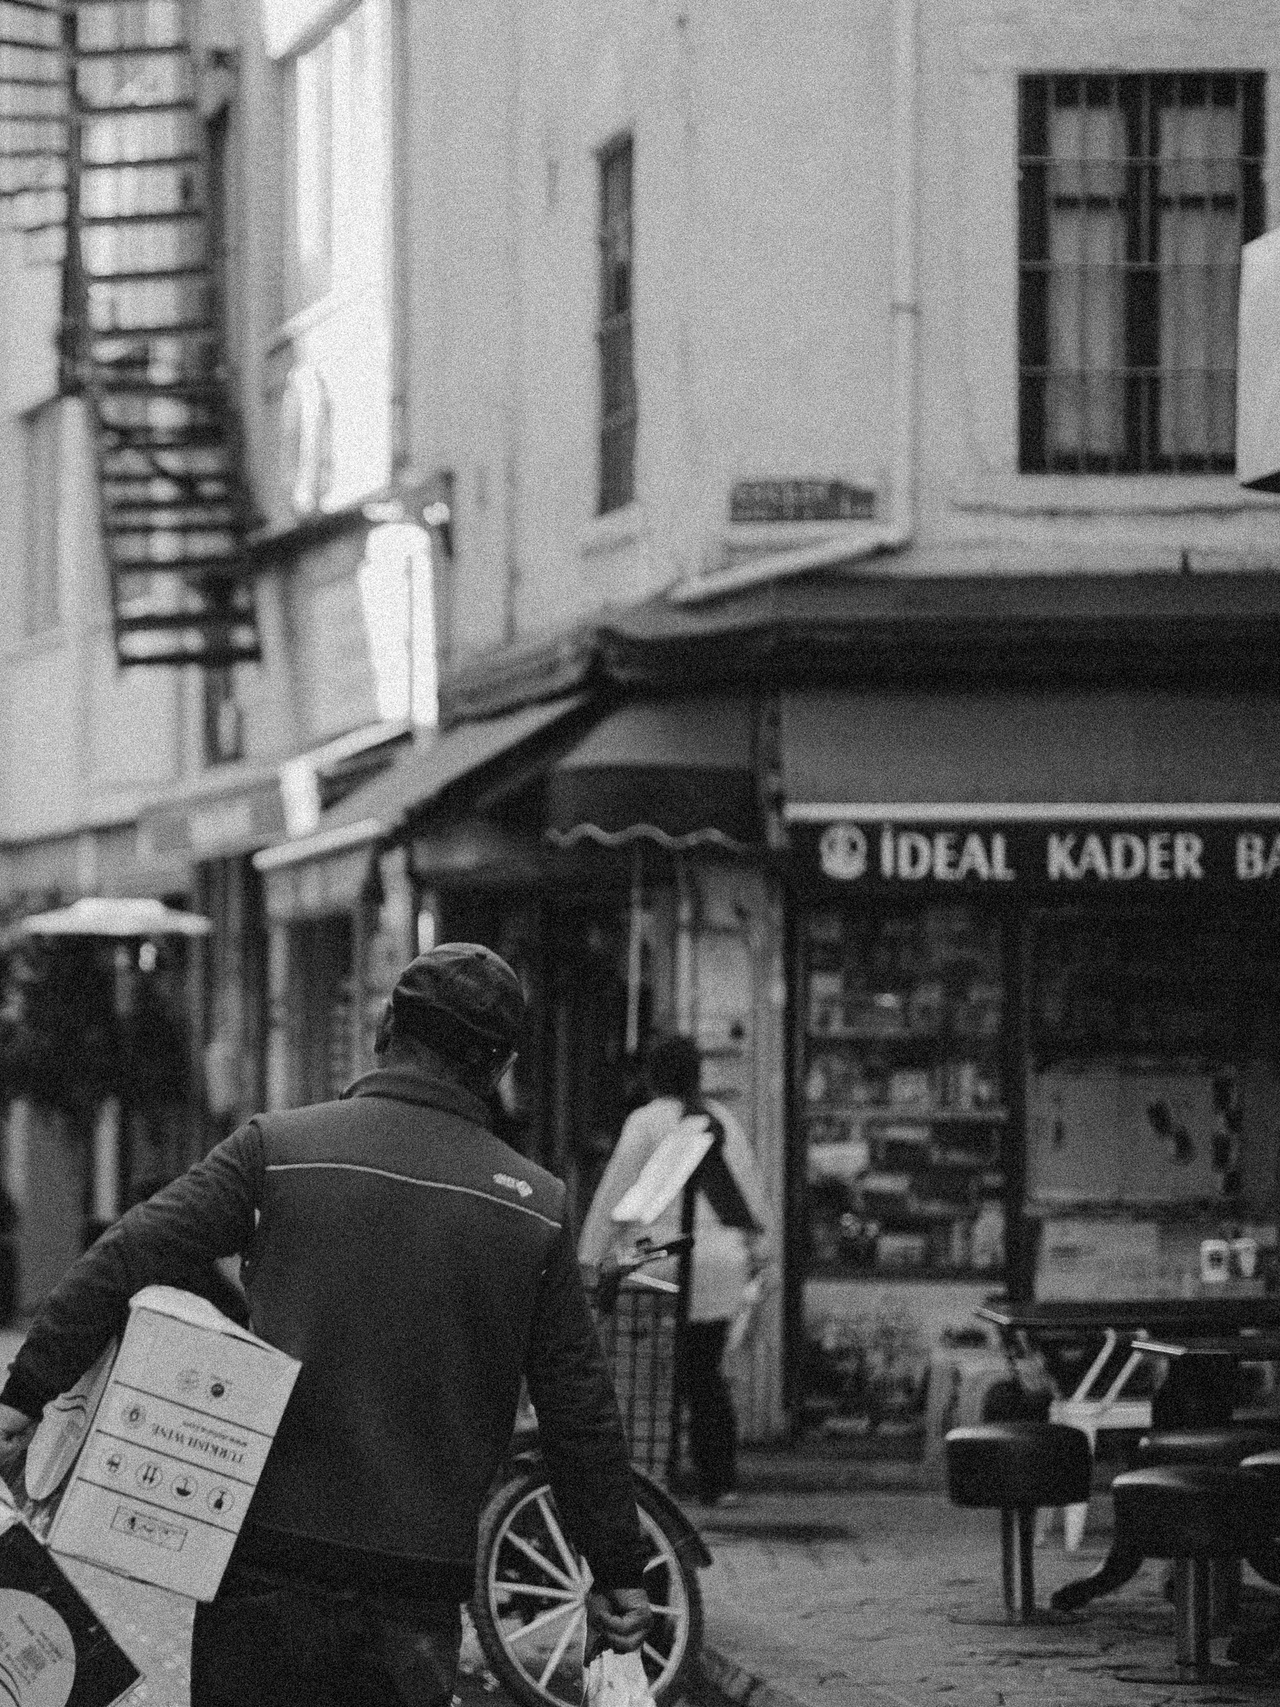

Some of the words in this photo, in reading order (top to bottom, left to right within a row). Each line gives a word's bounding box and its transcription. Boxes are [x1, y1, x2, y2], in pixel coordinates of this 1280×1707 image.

[1047, 832, 1204, 880] KADER
[151, 1423, 186, 1445] WINE
[187, 1438, 245, 1463] TURKISH
